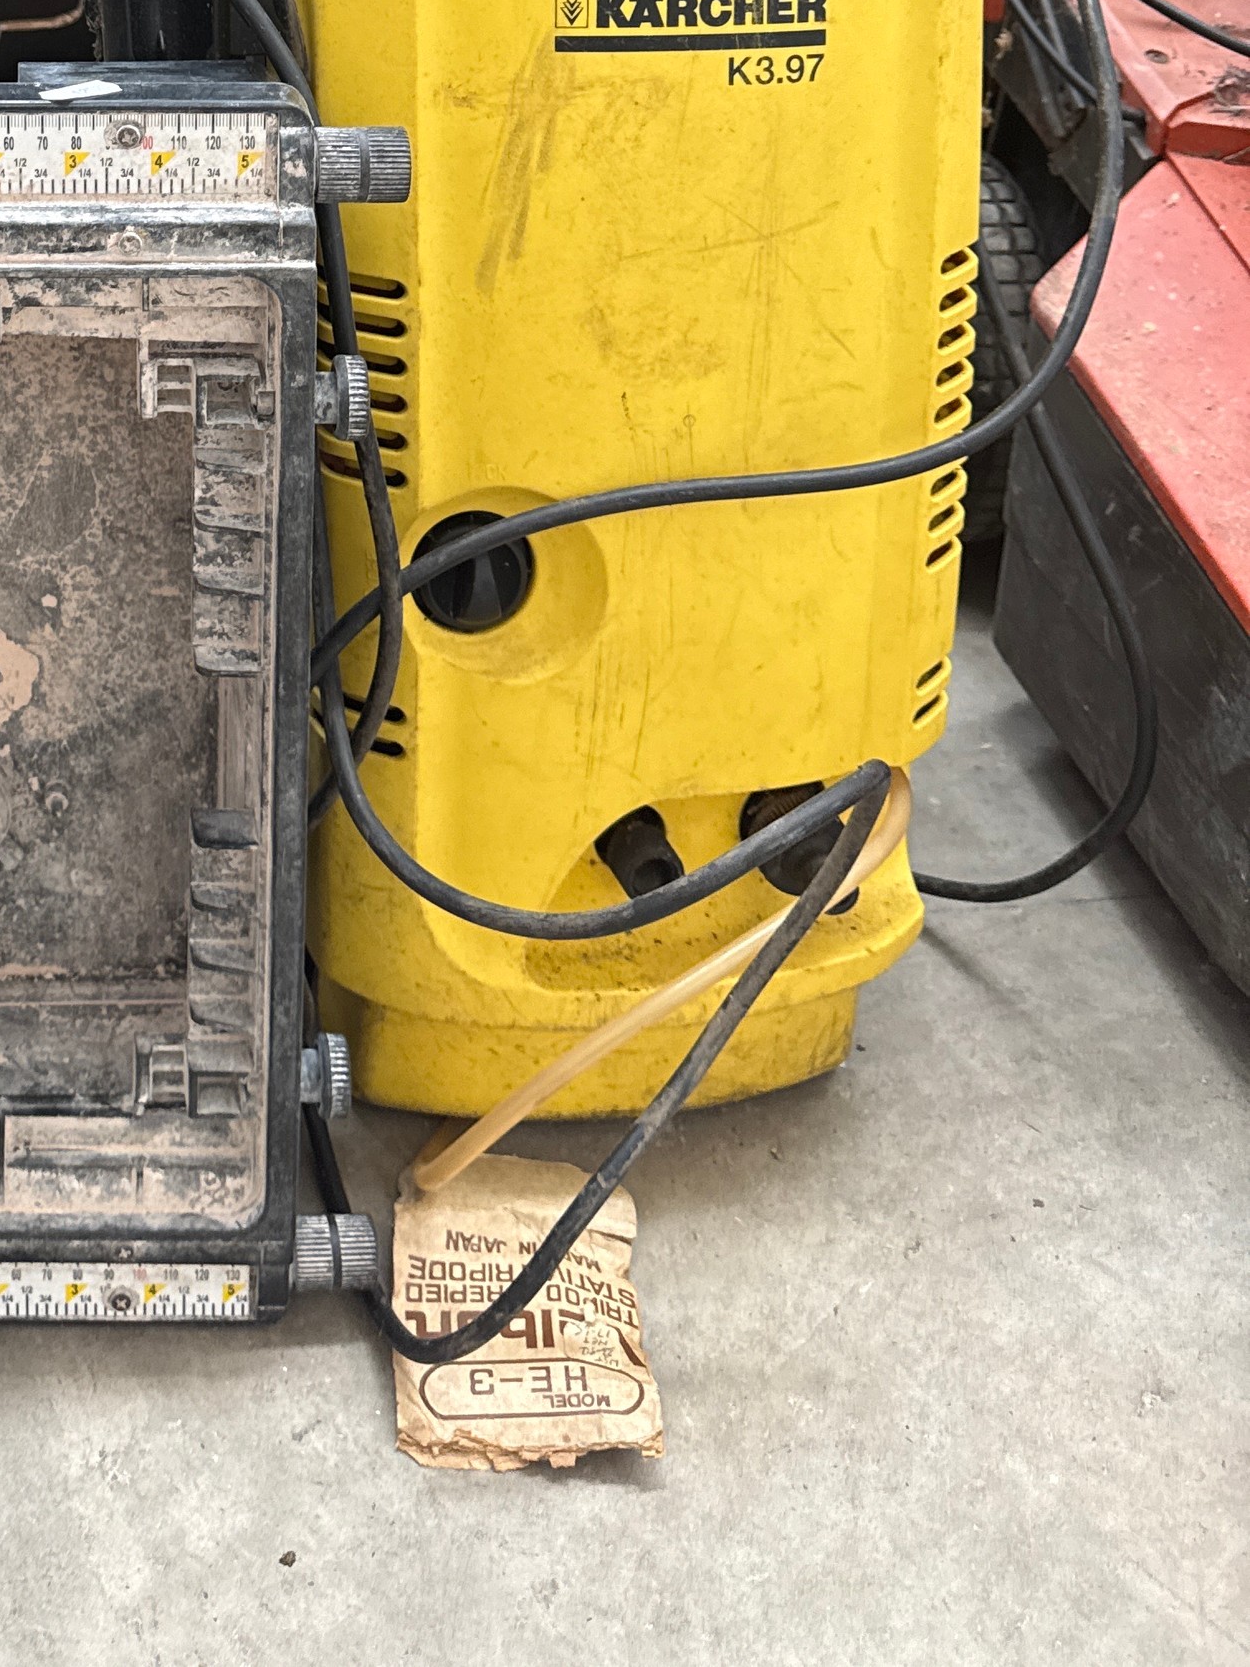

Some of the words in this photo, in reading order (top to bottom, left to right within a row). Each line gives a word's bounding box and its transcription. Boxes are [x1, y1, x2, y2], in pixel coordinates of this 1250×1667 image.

[727, 53, 825, 86] K3.97
[3, 136, 14, 150] 60
[37, 136, 48, 150] 70
[71, 136, 82, 150] 80
[140, 136, 153, 150] 00
[171, 136, 187, 149] 110
[205, 136, 221, 149] 120
[239, 136, 255, 149] 130
[14, 158, 27, 167] 1/2
[100, 158, 113, 167] 1/2
[186, 157, 199, 167] 1/2
[69, 156, 77, 168] 3
[155, 155, 163, 168] 4
[241, 155, 249, 168] 5
[445, 1229, 508, 1253] JAPAN
[518, 1241, 537, 1255] IN
[11, 1269, 21, 1280] 60
[42, 1269, 52, 1280] 70
[73, 1269, 83, 1280] 80
[103, 1269, 114, 1280] 90
[163, 1269, 178, 1280] 110
[195, 1269, 209, 1281] 120
[225, 1269, 240, 1281] 130
[407, 1254, 518, 1282] RIPODE
[71, 1285, 79, 1295] 3
[149, 1285, 156, 1295] 4
[227, 1285, 235, 1295] 5
[405, 1282, 504, 1304] REPIED
[469, 1365, 588, 1395] HE-3
[543, 1393, 611, 1409] MODEL
